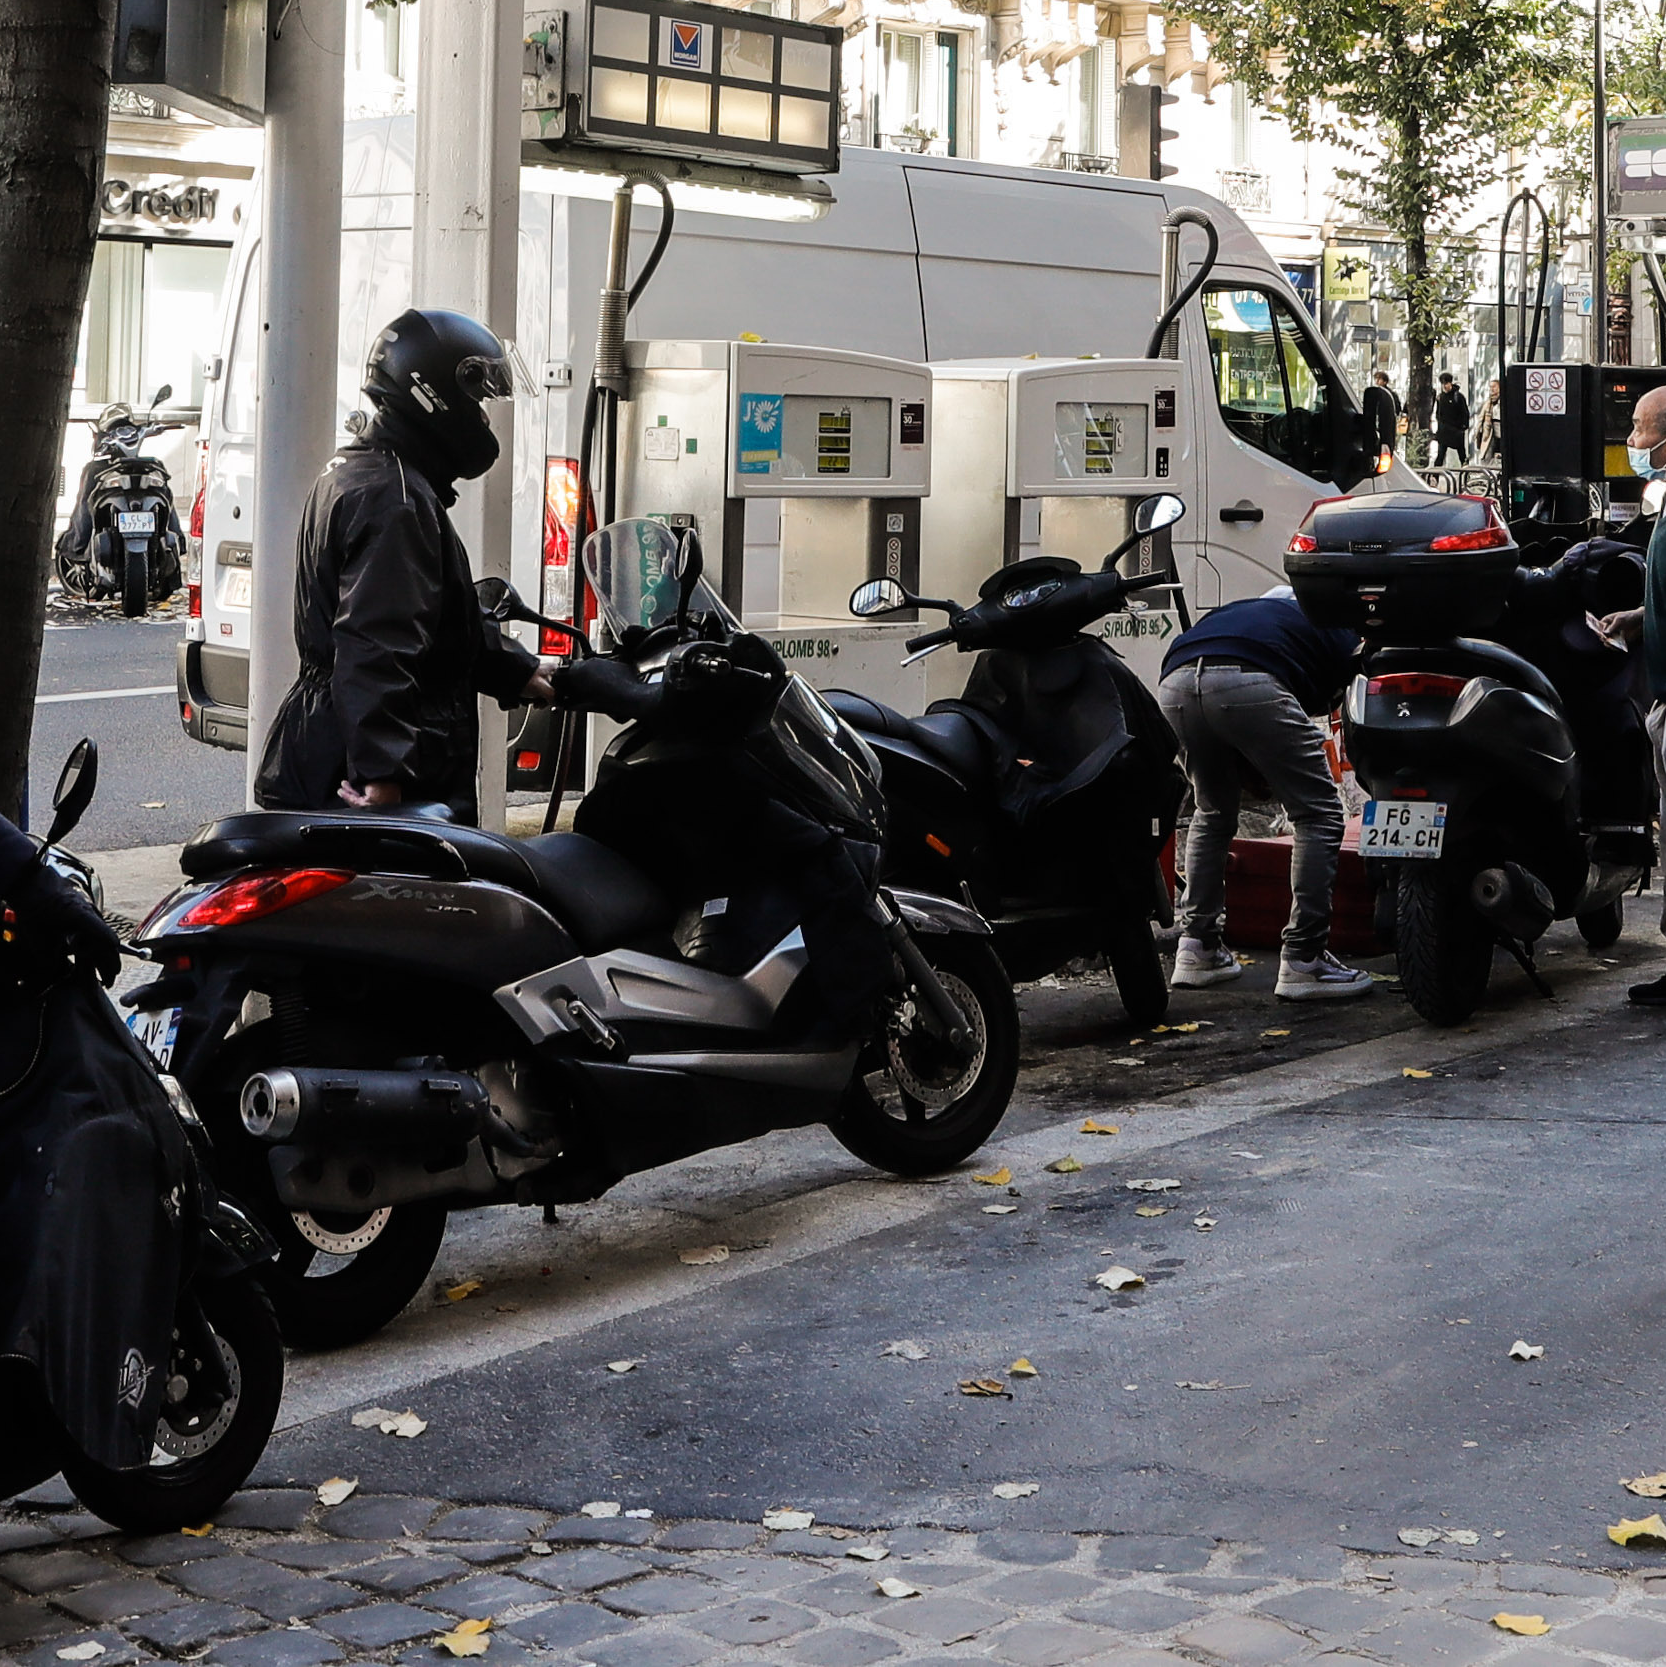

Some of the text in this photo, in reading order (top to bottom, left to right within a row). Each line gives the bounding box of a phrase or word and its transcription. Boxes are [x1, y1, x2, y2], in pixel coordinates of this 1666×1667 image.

[101, 180, 221, 223] Crédit
[410, 371, 449, 411] LS2
[1104, 619, 1147, 638] S/PLOB
[817, 639, 831, 658] 98
